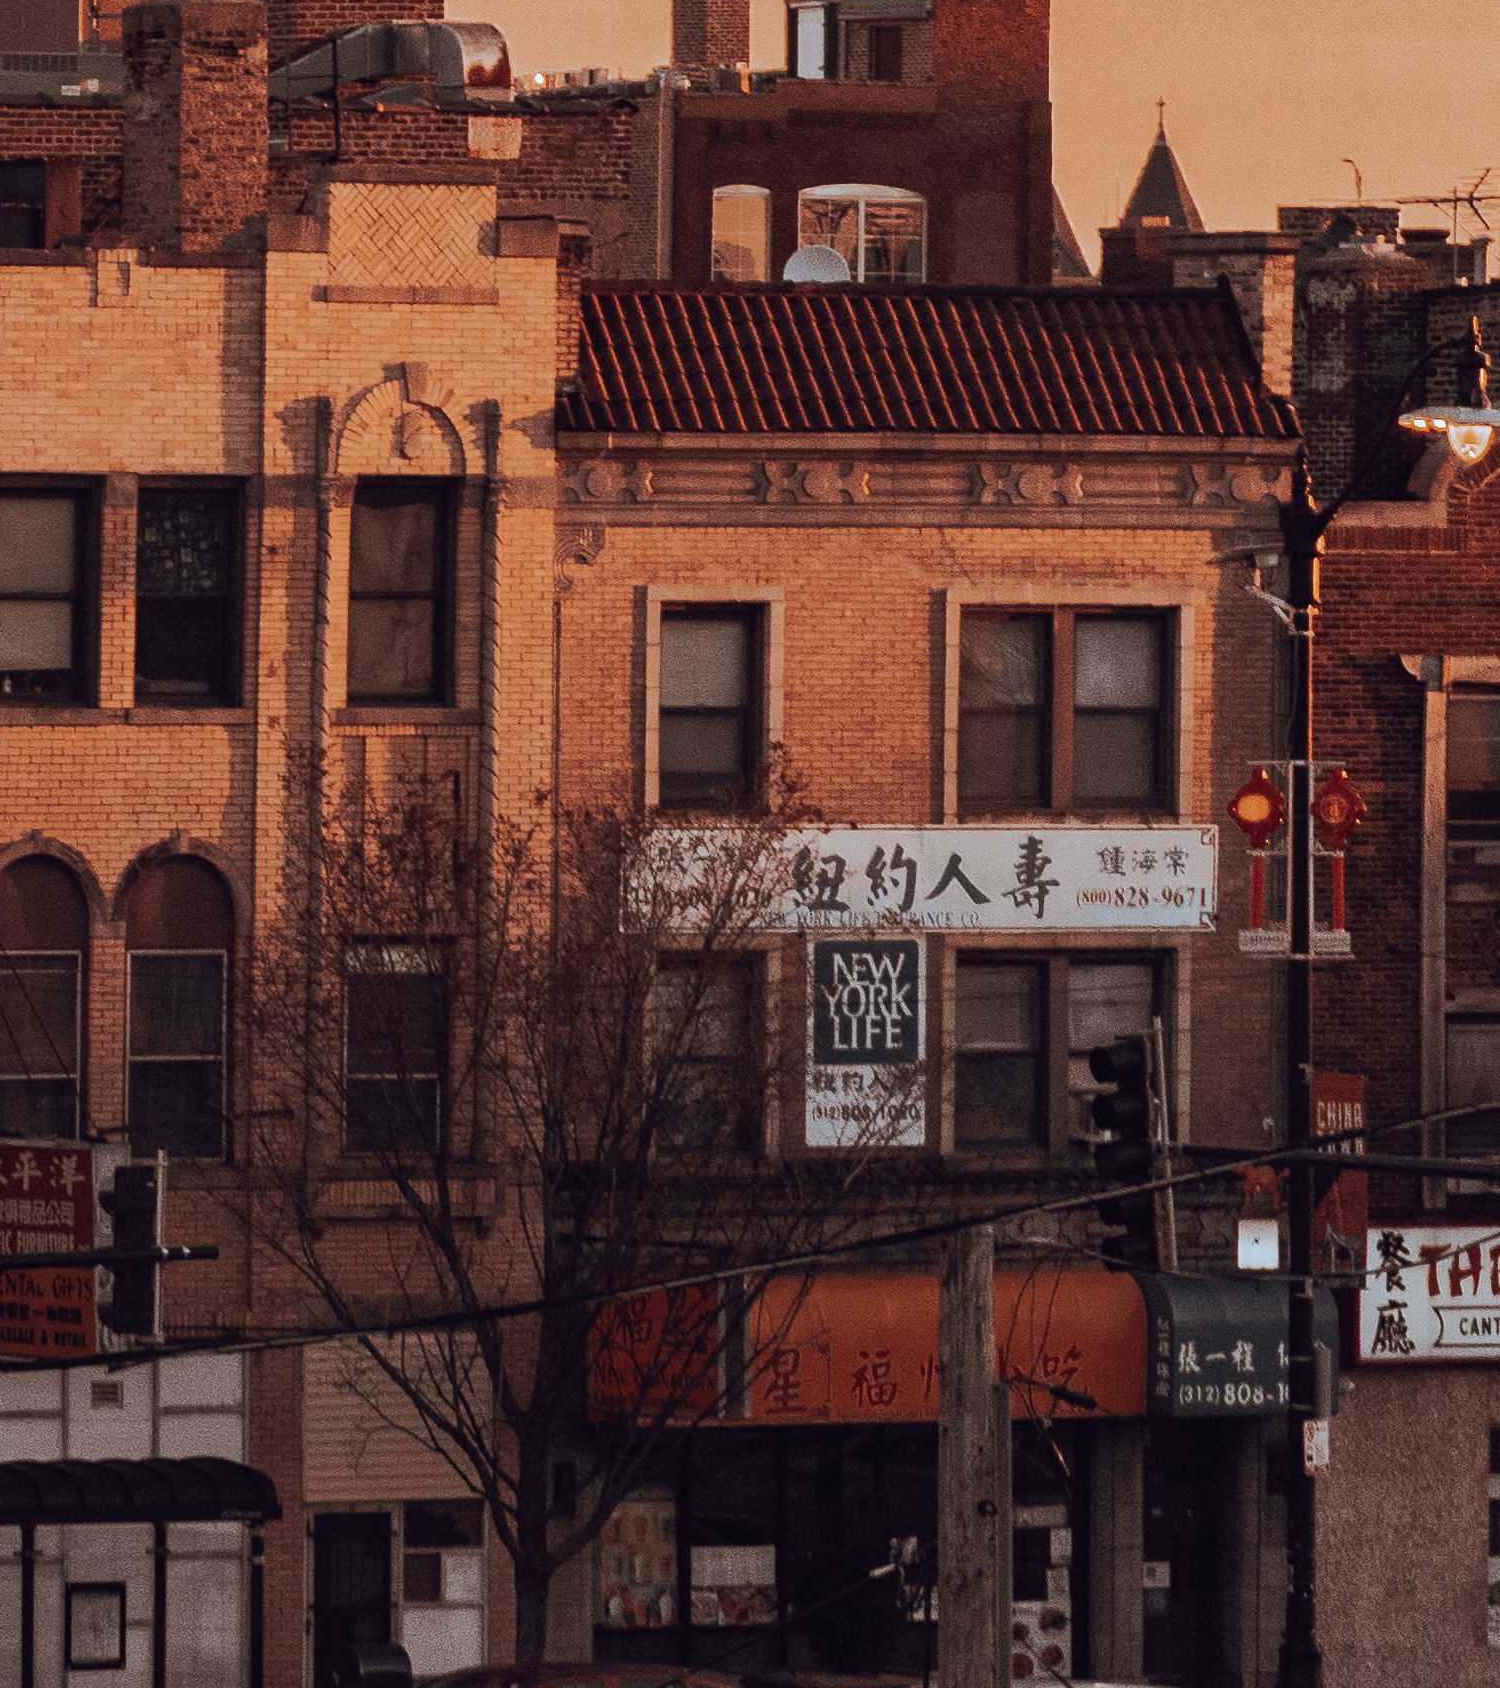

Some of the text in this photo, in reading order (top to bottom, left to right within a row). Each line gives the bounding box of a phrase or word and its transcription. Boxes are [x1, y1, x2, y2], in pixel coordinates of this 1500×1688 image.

[791, 835, 1060, 919] 紐約人壽
[832, 952, 905, 985] NEW
[820, 982, 914, 1018] YORK
[832, 1015, 904, 1050] LIFE
[1316, 1100, 1363, 1130] CHINA
[52, 1273, 93, 1301] GIFTS
[53, 1331, 87, 1348] RETAIL
